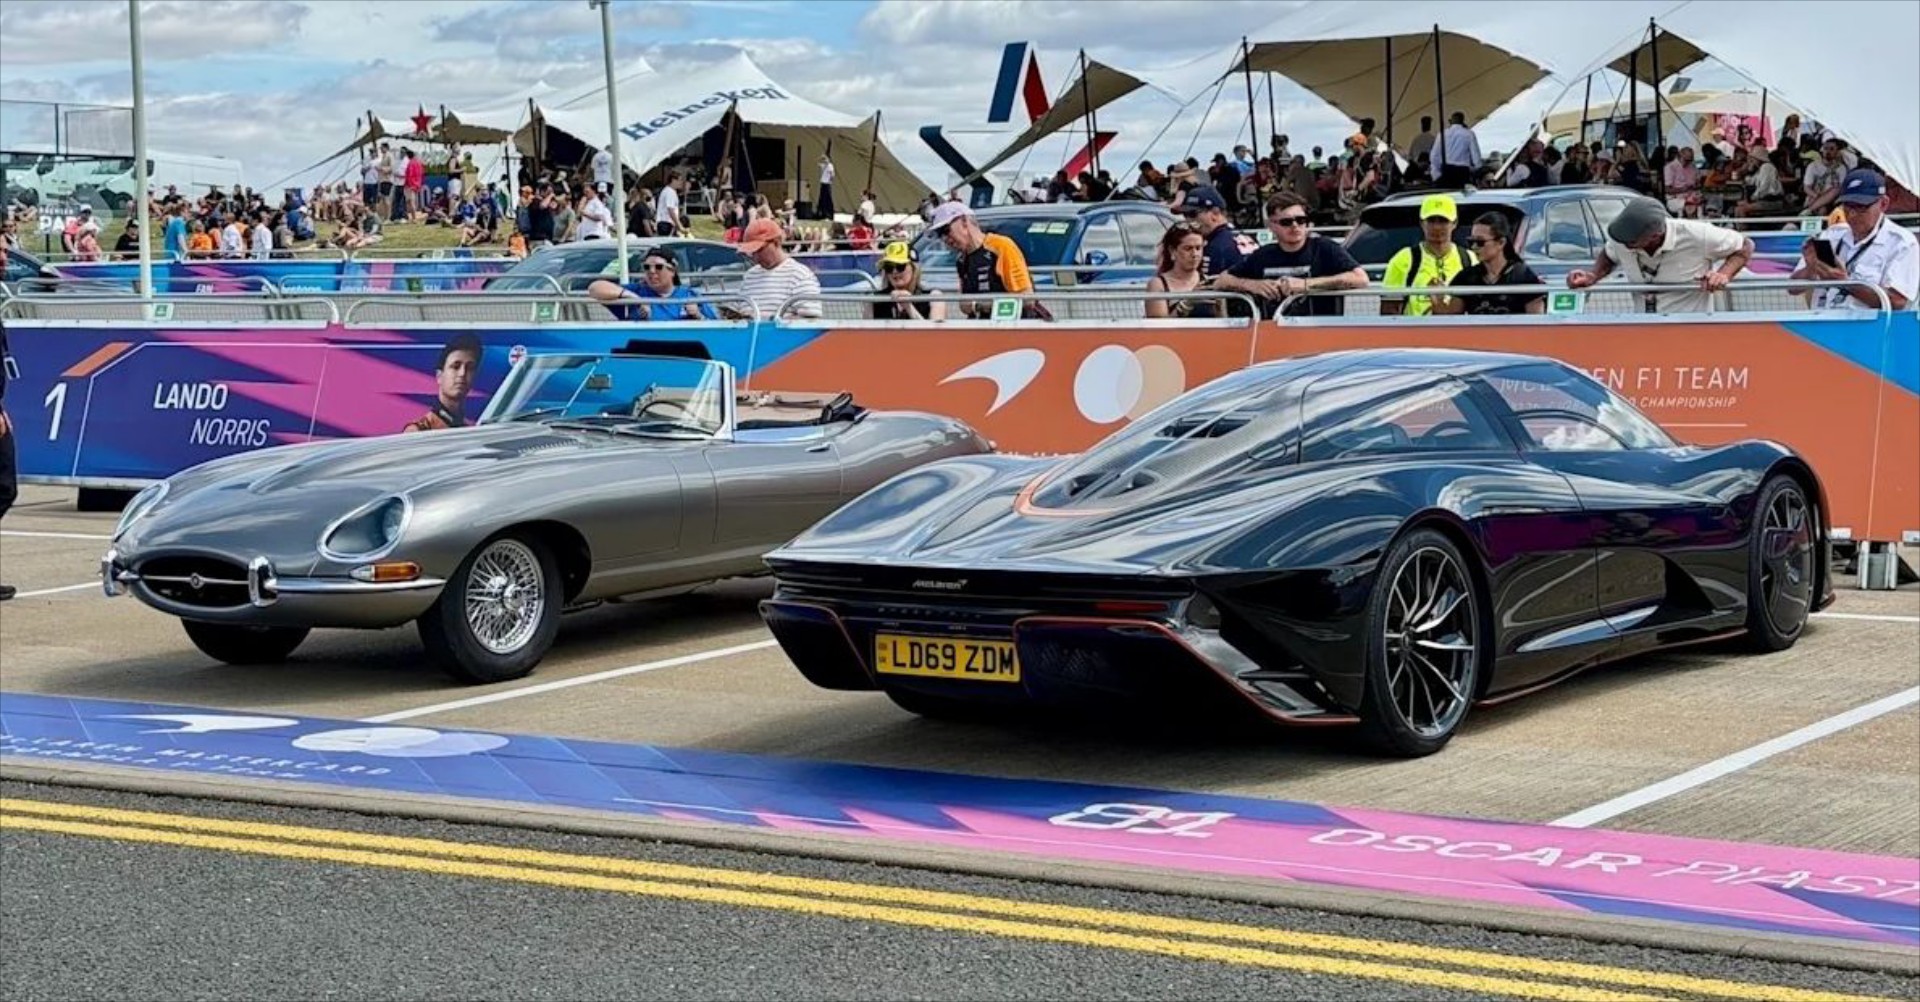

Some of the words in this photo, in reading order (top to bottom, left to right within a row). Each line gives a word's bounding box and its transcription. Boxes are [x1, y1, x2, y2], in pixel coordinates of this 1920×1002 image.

[618, 86, 790, 141] Heineken
[1637, 367, 1661, 389] F1
[1675, 367, 1749, 389] TEAM
[45, 382, 67, 440] 1
[153, 382, 228, 410] LANDO
[1641, 396, 1737, 409] CHAMPIONSHIP
[190, 418, 270, 446] NORRIS
[892, 640, 956, 671] LD69
[964, 645, 1015, 675] ZDM
[1048, 803, 1237, 838] 81
[1308, 828, 1642, 873] OSCAR
